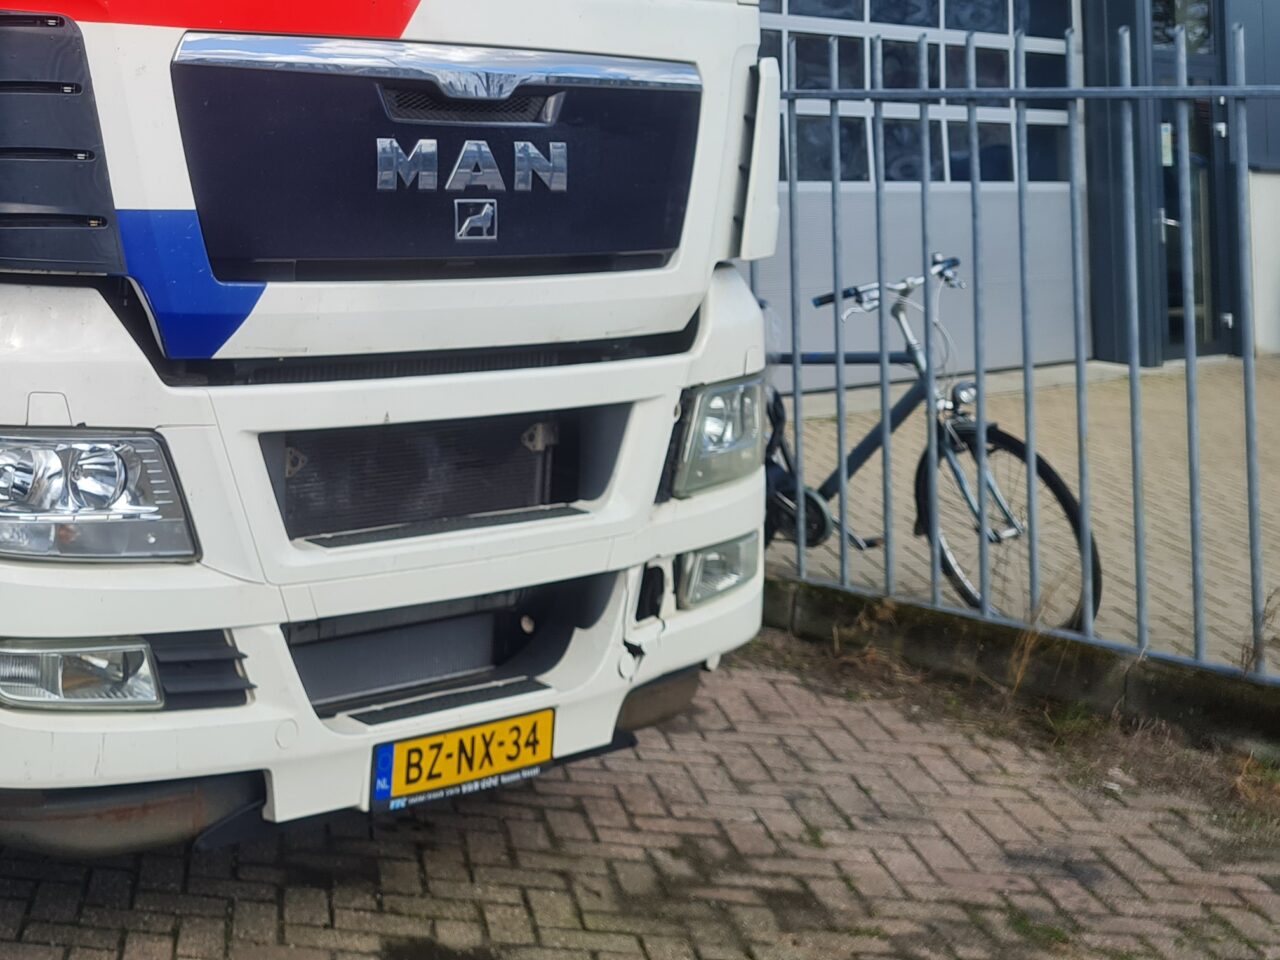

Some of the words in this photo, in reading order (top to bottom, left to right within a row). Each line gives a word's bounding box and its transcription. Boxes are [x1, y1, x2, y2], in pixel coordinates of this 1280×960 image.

[376, 137, 568, 192] MAN
[404, 720, 541, 787] BZ-NX-34
[376, 777, 391, 791] NL
